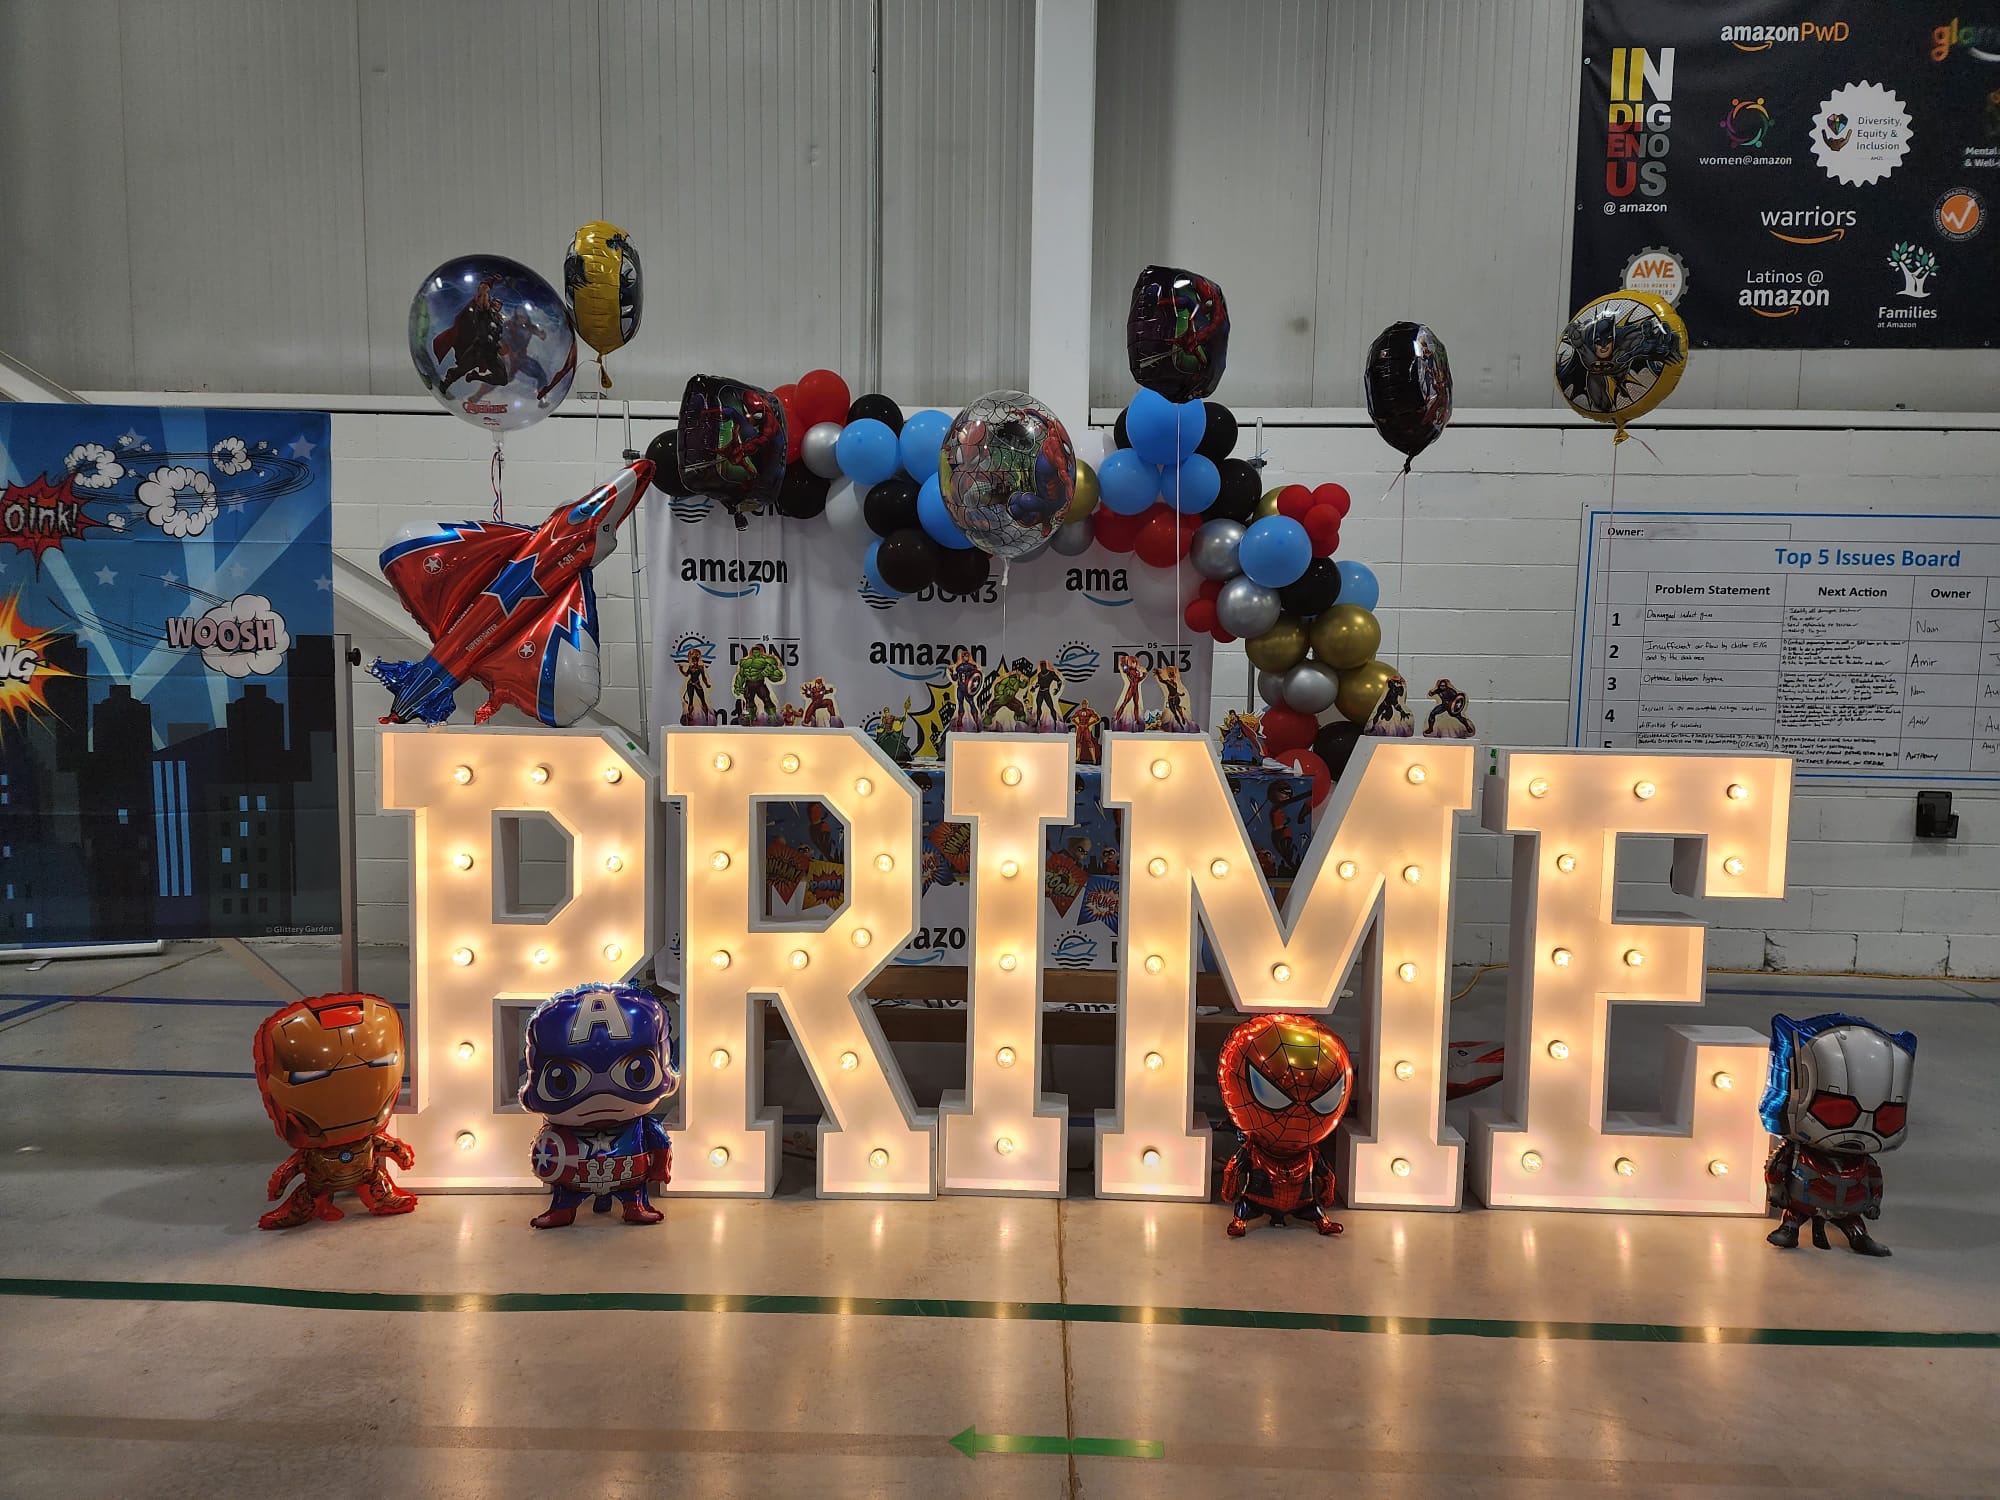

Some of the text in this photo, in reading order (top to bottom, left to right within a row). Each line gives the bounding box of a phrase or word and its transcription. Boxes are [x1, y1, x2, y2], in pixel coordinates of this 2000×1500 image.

[1858, 116, 1902, 127] Diversity,
[1857, 130, 1898, 140] Equity &
[1856, 141, 1900, 150] Inclusion
[1699, 155, 1792, 166] women@amazon
[1603, 202, 1668, 215] @ amazon
[1760, 206, 1857, 227] warriors
[1632, 260, 1675, 279] AWE
[1747, 269, 1824, 287] Latinos @
[1738, 289, 1830, 306] amazon
[1878, 306, 1938, 319] Families
[1887, 321, 1917, 329] Amazon
[1607, 527, 1645, 537] Owner:
[1775, 548, 1961, 569] Top 5 Issues Board
[680, 558, 788, 584] amazon
[1065, 567, 1129, 592] ama
[1655, 584, 1771, 596] Problem Statement
[1818, 586, 1888, 598] Next Action
[1930, 588, 1971, 599] Owner
[1612, 612, 1621, 627] 1
[166, 616, 277, 651] WOOSH
[869, 641, 987, 667] amazon
[1609, 645, 1619, 659] 2
[1607, 676, 1617, 691] 3
[1605, 709, 1616, 723] 4
[810, 879, 843, 895] POW
[273, 926, 305, 935] Glittery
[305, 925, 334, 934] Garden
[905, 927, 969, 950] azo
[380, 728, 1794, 1217] PRIME
